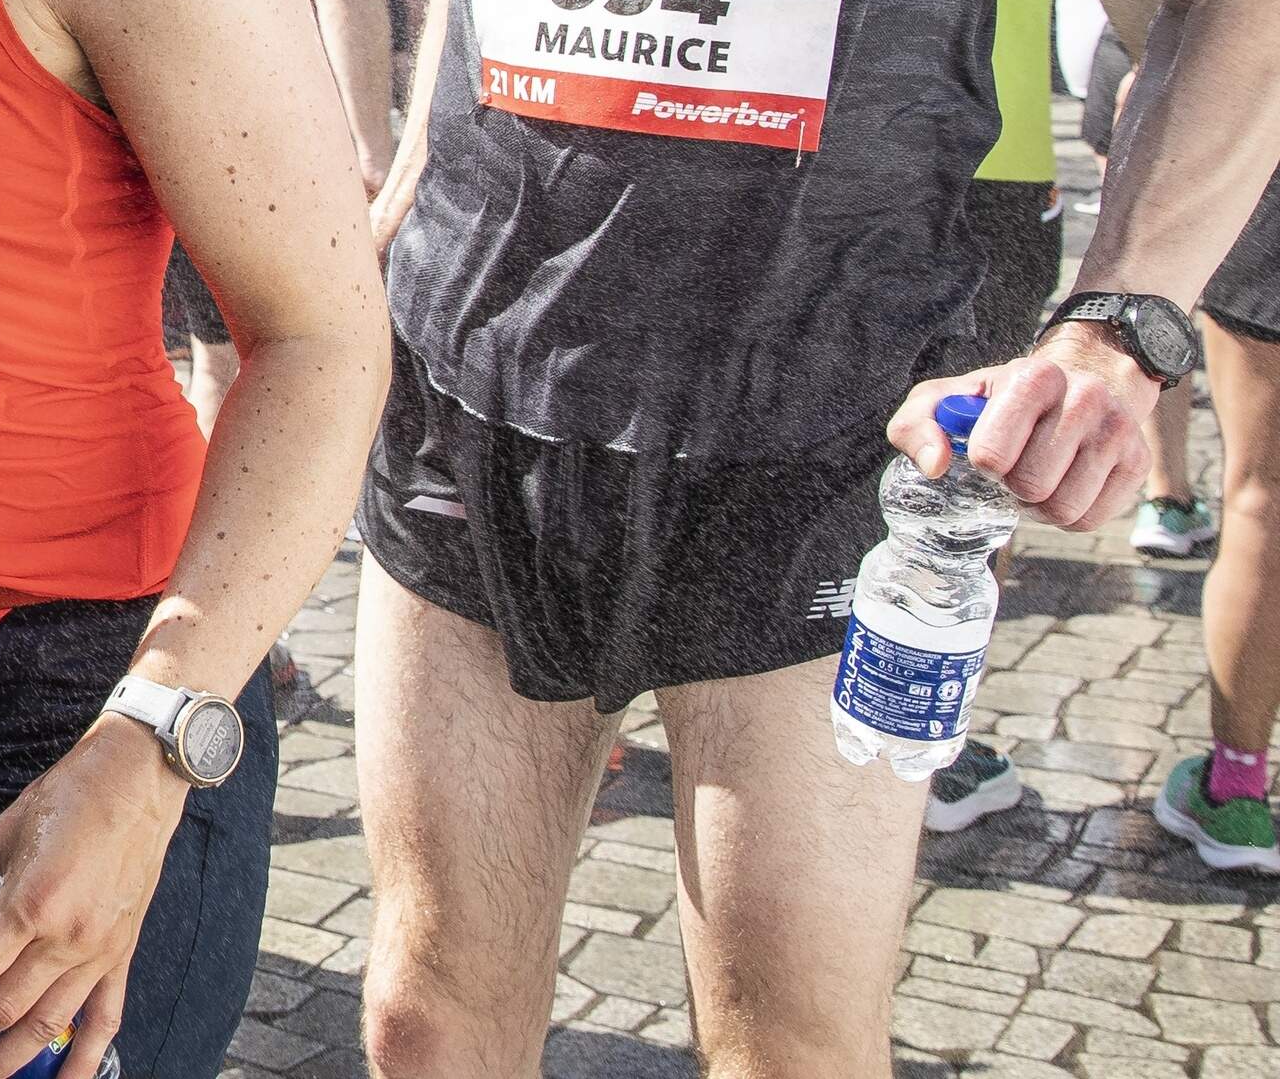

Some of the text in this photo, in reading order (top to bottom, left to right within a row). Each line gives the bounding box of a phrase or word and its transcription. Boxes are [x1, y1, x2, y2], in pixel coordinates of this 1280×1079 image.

[535, 22, 731, 73] MAURICE
[489, 68, 556, 105] 21 KM
[632, 92, 802, 131] Powerbar
[839, 623, 866, 710] DALPHIN
